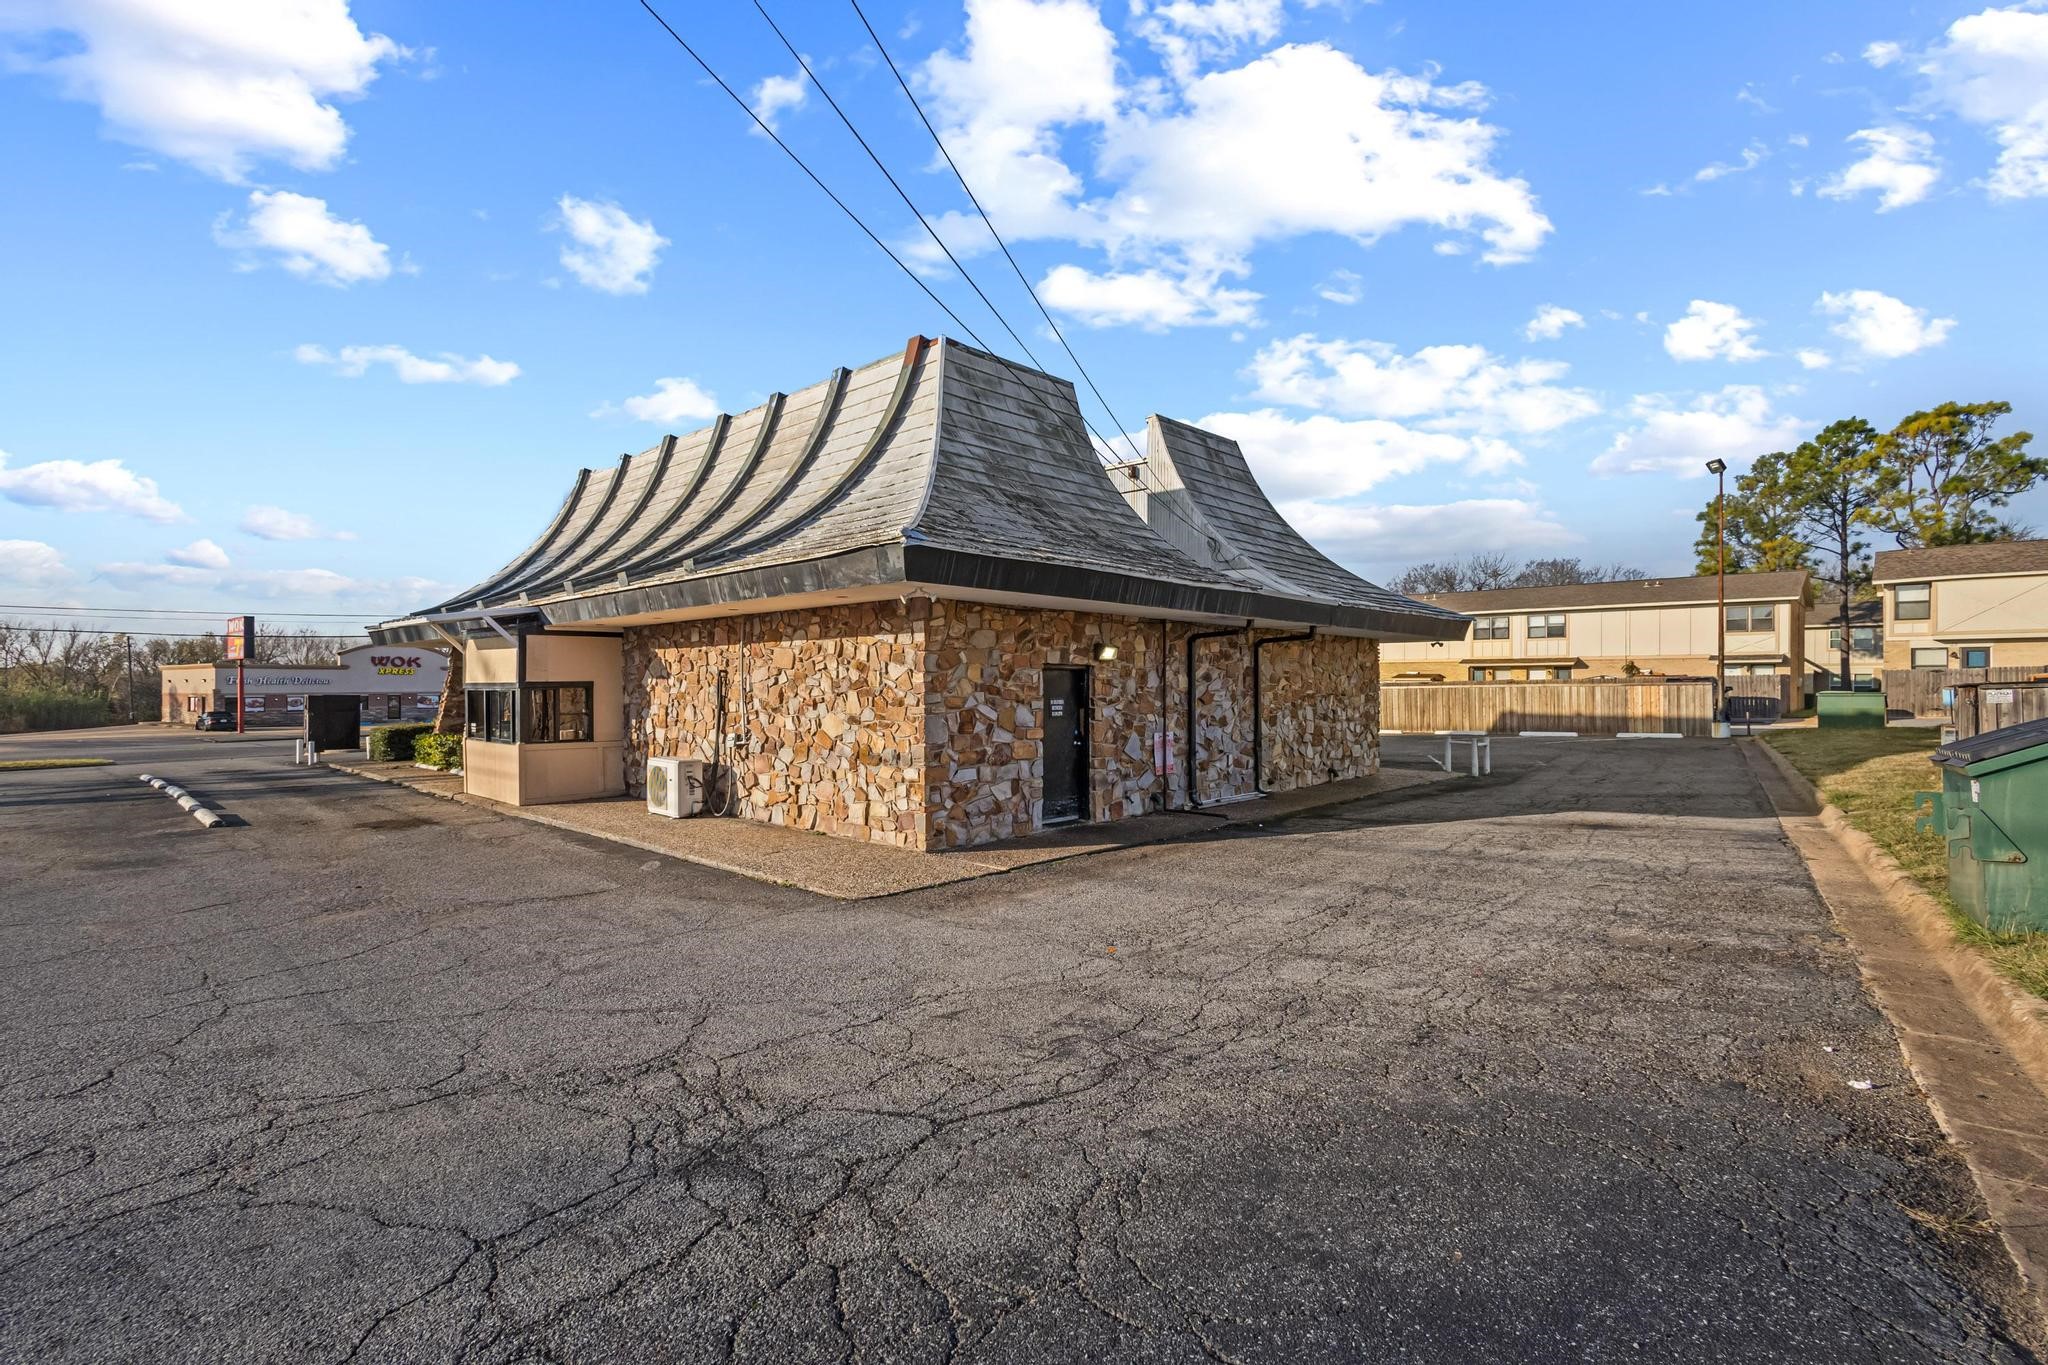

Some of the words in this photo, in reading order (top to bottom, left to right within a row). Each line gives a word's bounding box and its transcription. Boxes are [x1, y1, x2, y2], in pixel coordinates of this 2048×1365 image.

[371, 656, 422, 668] WOK
[377, 667, 416, 675] XPRESS
[255, 676, 289, 686] Health
